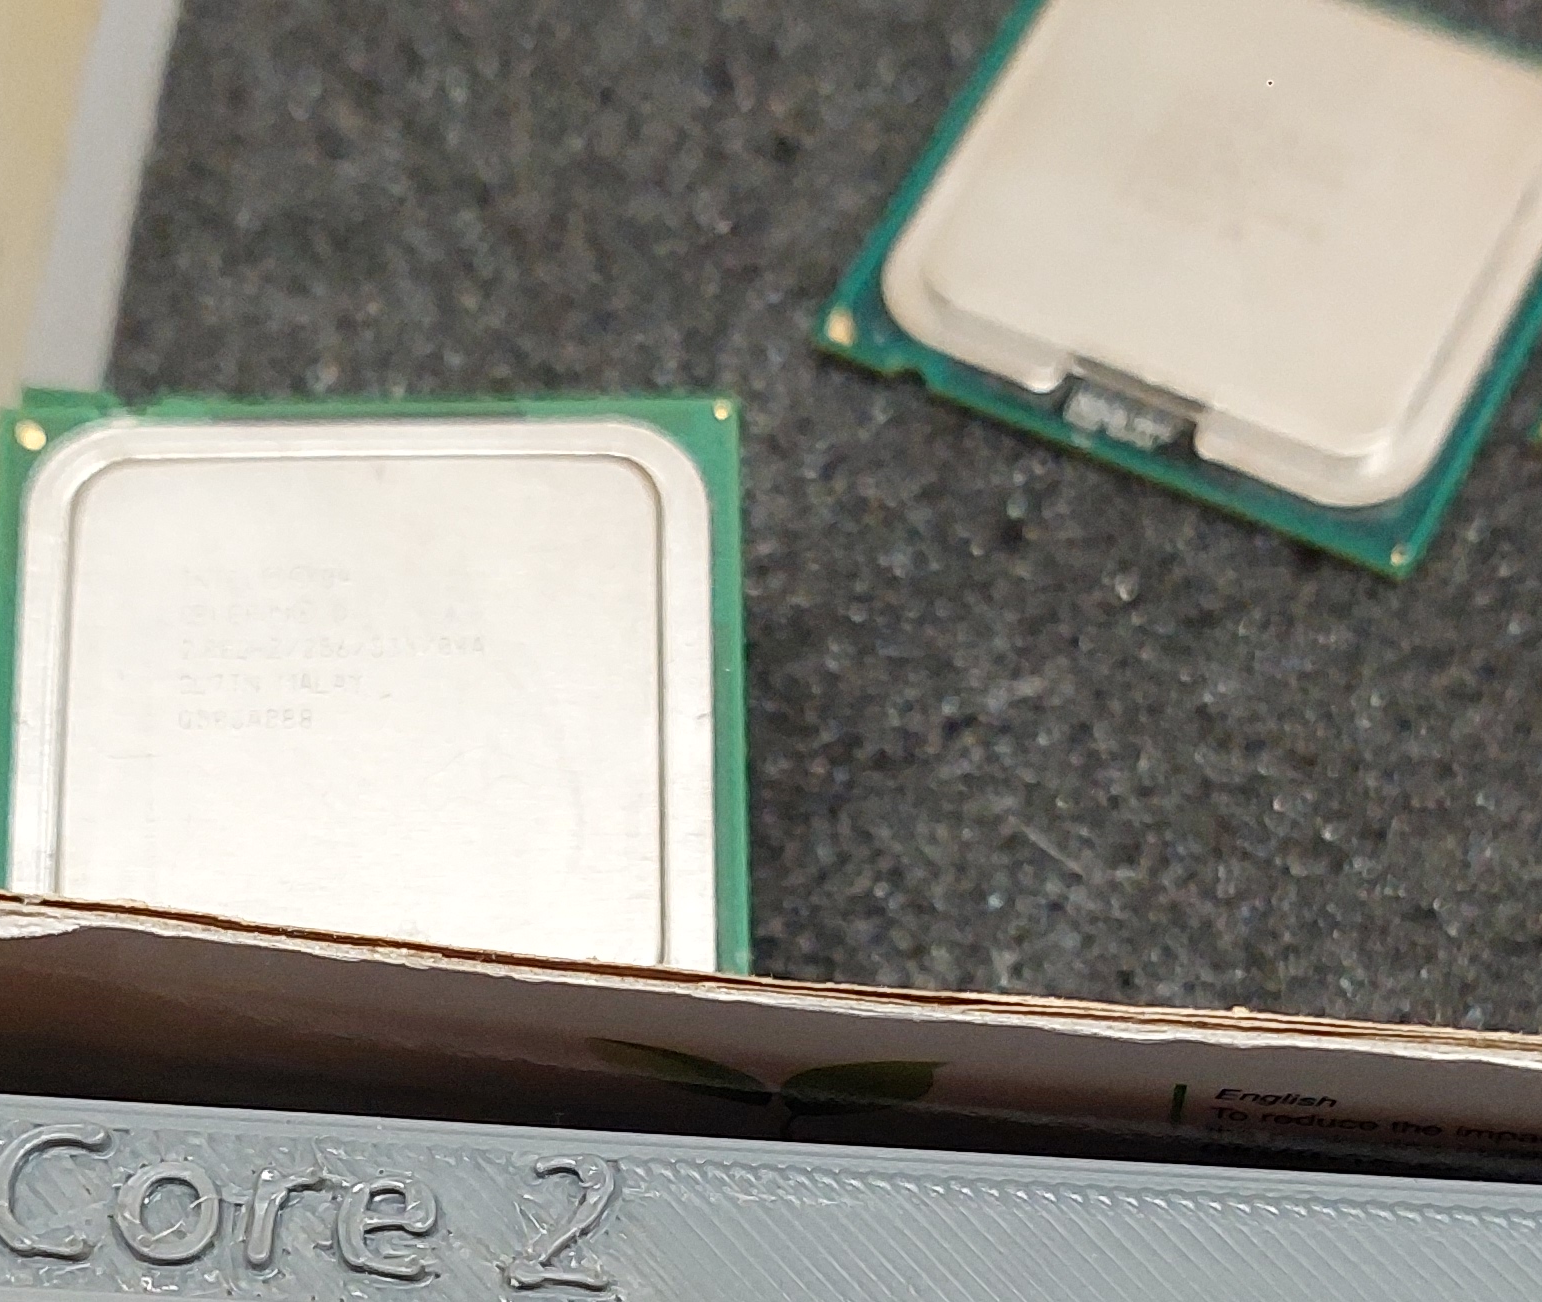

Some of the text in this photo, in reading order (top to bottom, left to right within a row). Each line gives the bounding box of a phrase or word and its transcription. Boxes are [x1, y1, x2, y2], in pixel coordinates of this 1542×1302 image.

[1213, 1087, 1338, 1109] English
[1210, 1105, 1249, 1122] To
[1261, 1112, 1379, 1132] reduce
[1391, 1119, 1444, 1137] the
[505, 1151, 625, 1292] 2
